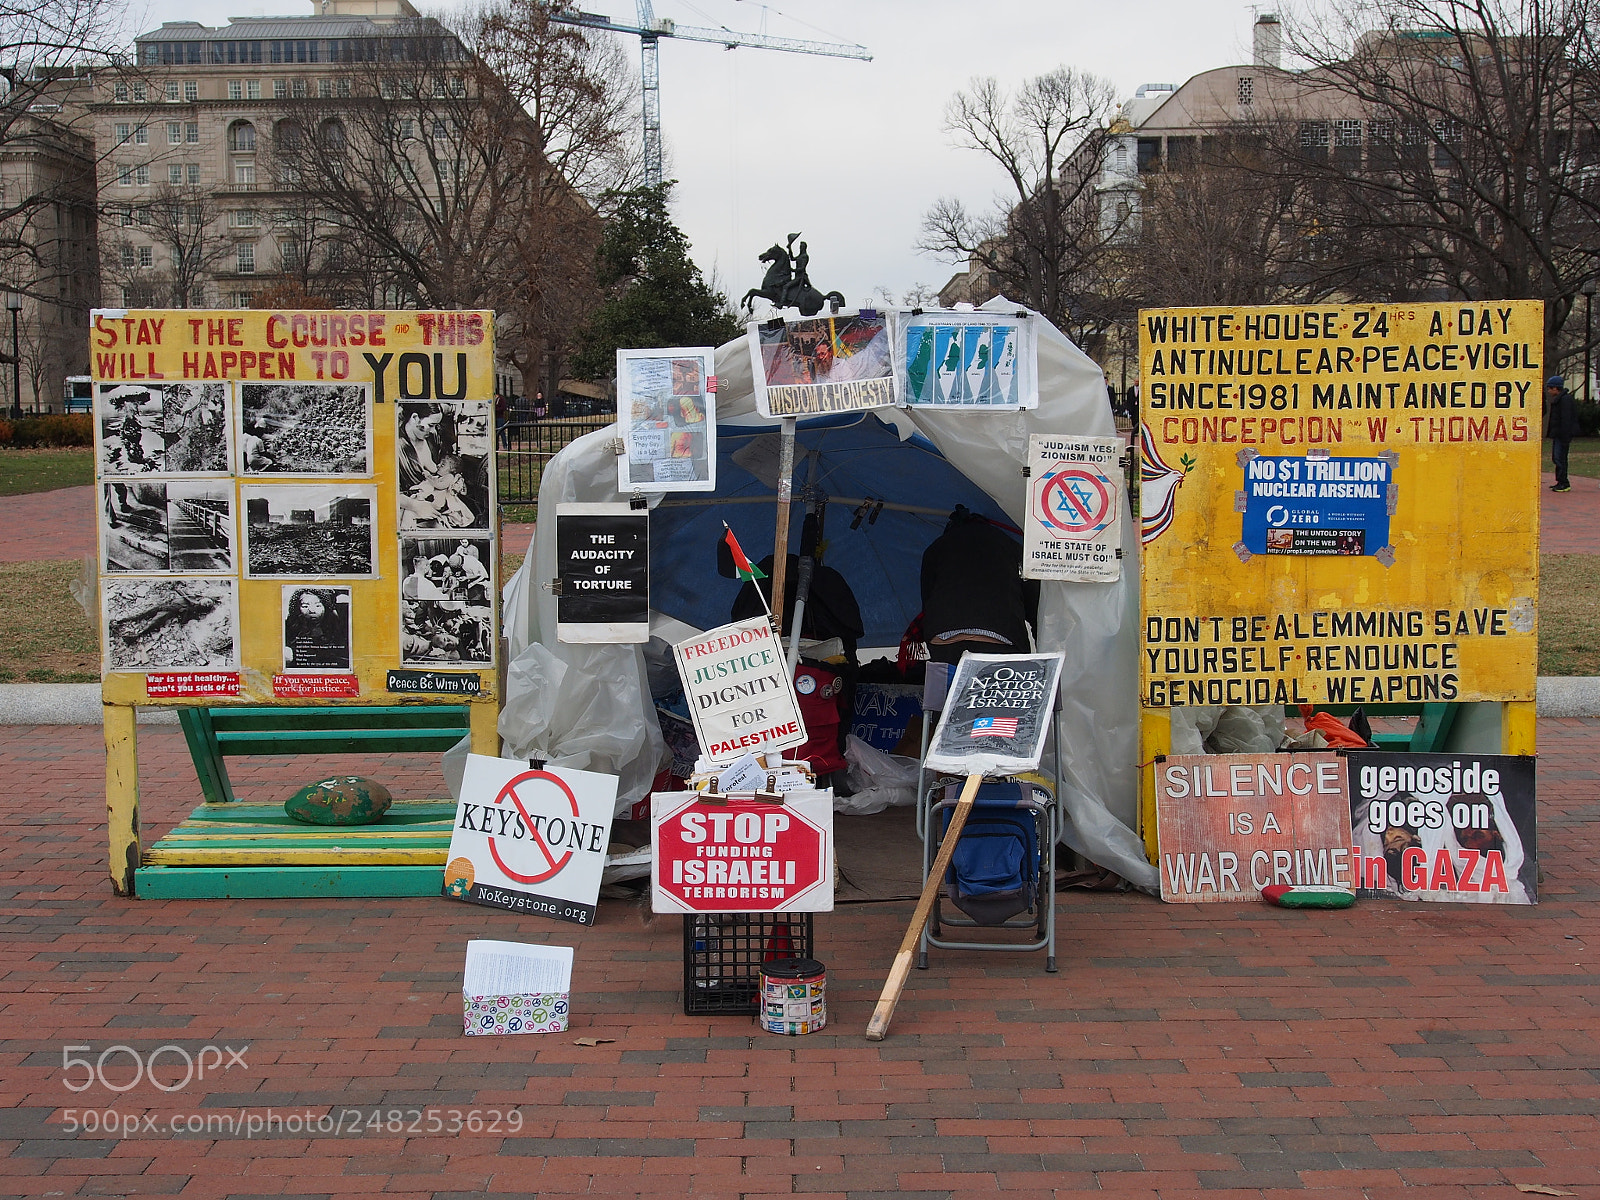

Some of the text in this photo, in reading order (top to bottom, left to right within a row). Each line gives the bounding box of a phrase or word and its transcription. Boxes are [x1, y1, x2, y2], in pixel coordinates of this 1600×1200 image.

[97, 314, 164, 348] STAY
[188, 319, 244, 346] THE
[266, 314, 386, 349] COURSE
[417, 314, 485, 346] THIS
[1147, 307, 1512, 344] WHITE HOUSE 24 HRS A DAY
[1150, 342, 1540, 377] ANTINUCLEAR PEACE VIGIL
[97, 351, 467, 404] WILL HAPPEN TO YOU
[767, 377, 892, 415] WISDOM & HONESTY
[1151, 380, 1532, 410] SINCE 1981 MAINTAINED BY
[1163, 416, 1343, 445] CONCEPCION
[1366, 416, 1388, 443] W
[1409, 415, 1529, 443] THOMAS
[1041, 451, 1112, 463] ZIONISM NO!"
[1092, 445, 1116, 454] YES!
[1249, 459, 1387, 482] NO $1 TRILLION
[1253, 482, 1381, 499] NUCLEAR ARSENAL
[1291, 514, 1319, 523] ZERO
[571, 550, 634, 559] AUDACITY
[590, 535, 615, 544] THE
[1039, 541, 1107, 552] "THE STATE OF
[595, 566, 611, 574] OF
[1031, 551, 1113, 563] ISRAEL MUST GO!"
[573, 580, 632, 589] TORTURE
[1231, 616, 1267, 642] BE
[1273, 614, 1290, 641] A
[1292, 611, 1424, 639] LEMMING
[1434, 608, 1508, 636] SAVE
[684, 626, 770, 661] FREEDOM
[1146, 643, 1458, 674] YOURSELF RENOUNCE
[148, 675, 164, 683] War
[324, 677, 350, 685] peace,
[694, 649, 774, 684] JUSTICE
[177, 685, 193, 693] you
[228, 683, 239, 691] it?
[275, 684, 342, 693] work for justice.
[698, 673, 781, 710] DIGNITY
[981, 689, 1042, 699] UNDER
[1149, 674, 1459, 706] GENOCIDAL WEAPONS
[731, 708, 768, 728] FOR
[710, 721, 798, 756] PALESTINE
[1165, 763, 1341, 798] SILENCE
[1360, 760, 1500, 798] genoside
[459, 802, 605, 853] KEYSTONE
[680, 812, 790, 844] STOP
[1229, 812, 1282, 835] IS A
[1368, 800, 1490, 834] goes on
[696, 846, 773, 858] FUNDING
[672, 860, 796, 885] ISRAELI
[1165, 848, 1350, 894] WAR CRIME
[1353, 846, 1509, 893] in GAZA
[478, 887, 587, 923] NoKeystone.org
[682, 886, 785, 898] TERRORISM
